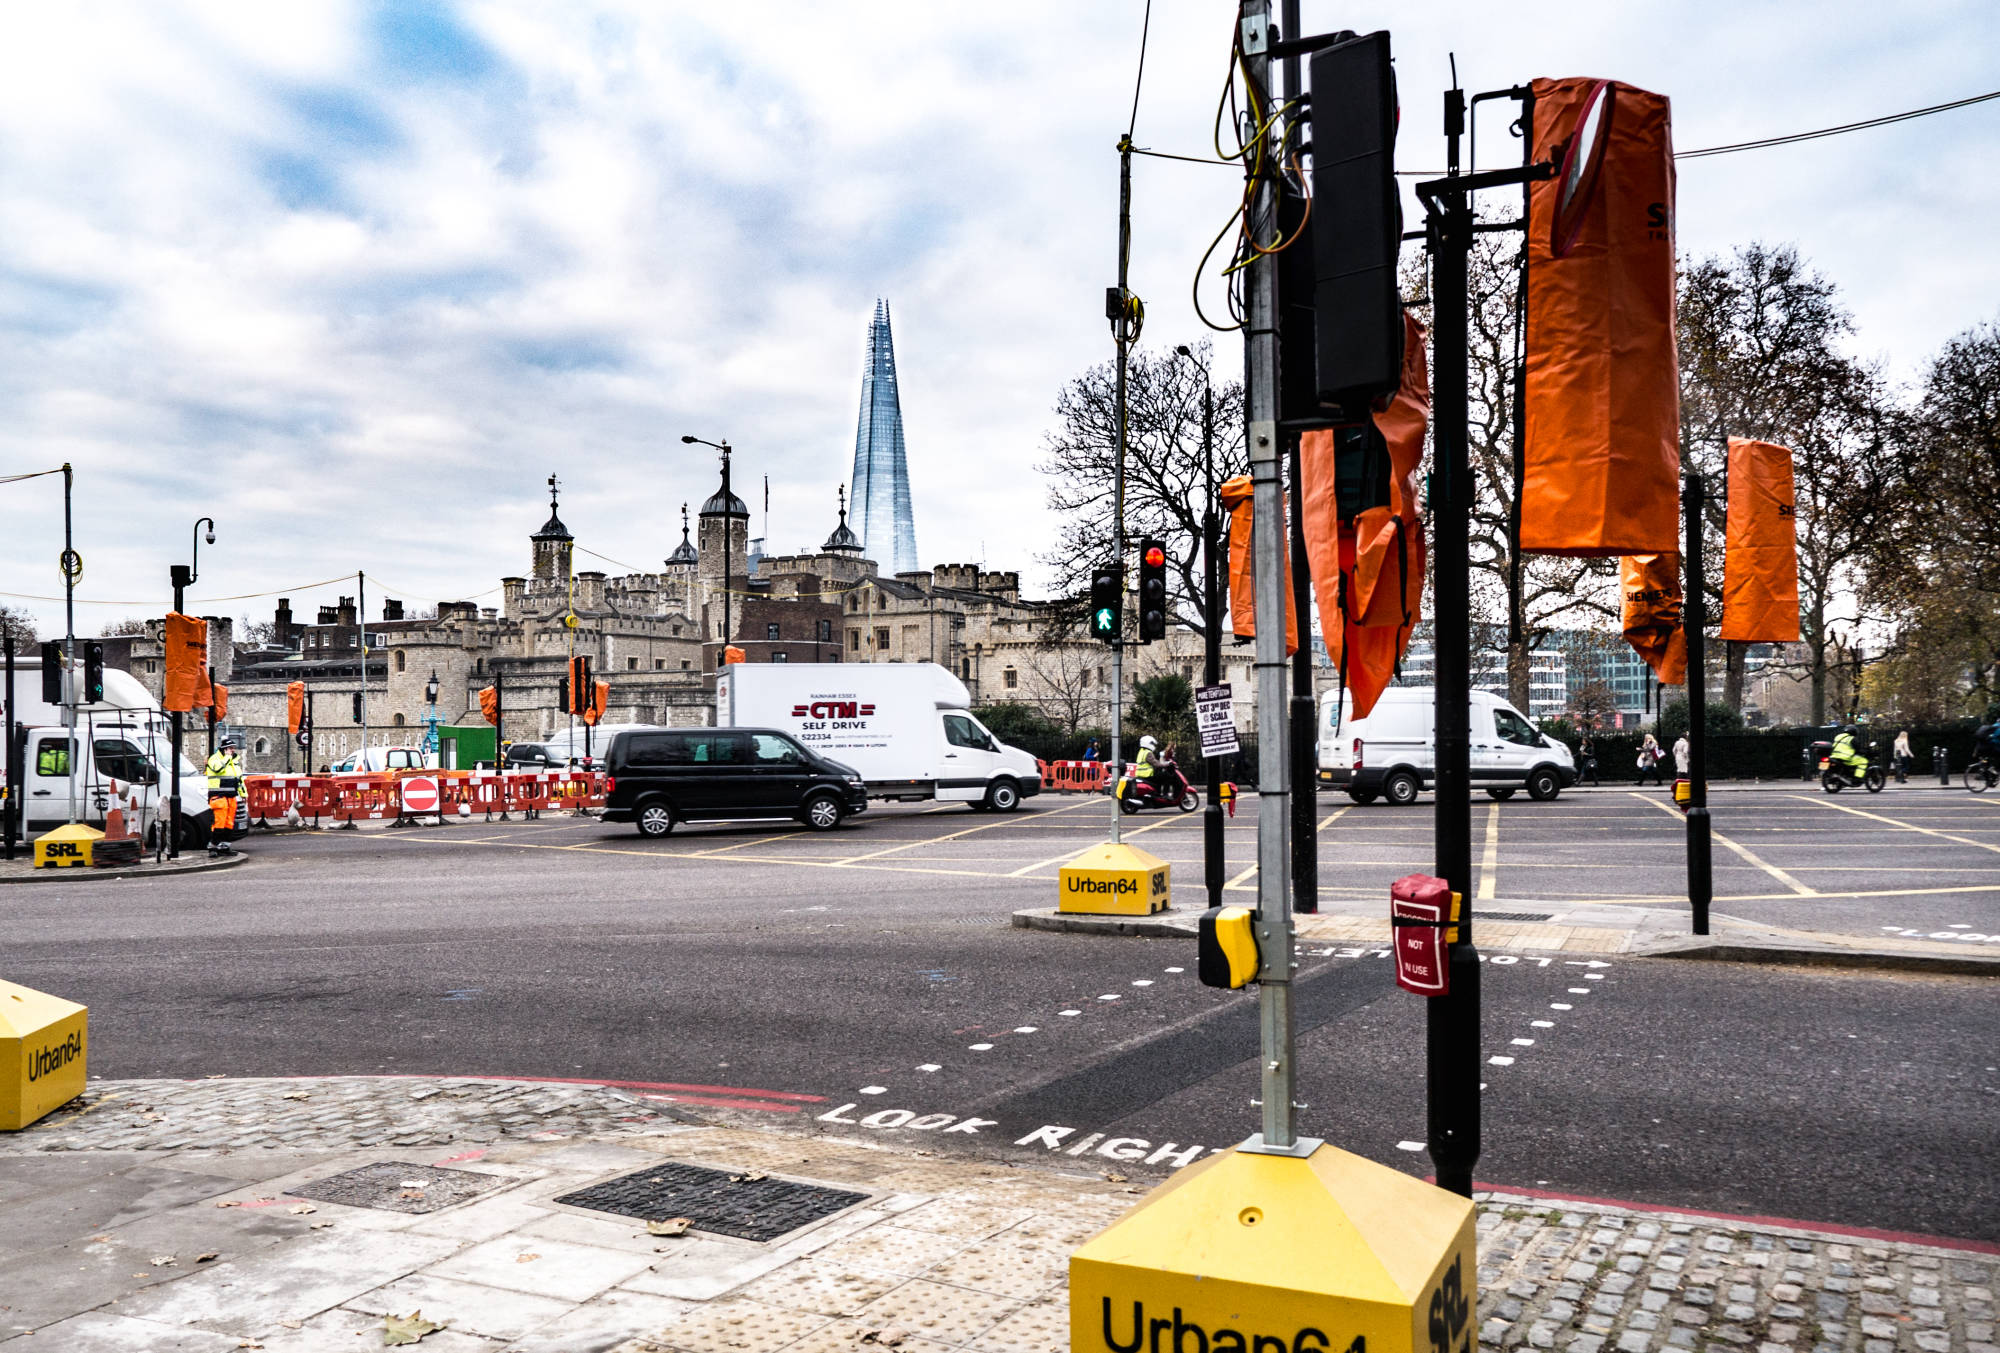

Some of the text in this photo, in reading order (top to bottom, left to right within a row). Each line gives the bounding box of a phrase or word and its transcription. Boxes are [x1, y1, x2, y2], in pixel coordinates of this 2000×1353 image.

[810, 701, 857, 719] CTM
[1199, 704, 1210, 713] SAT
[1220, 701, 1231, 711] DEC
[1210, 711, 1228, 721] SCALA
[802, 721, 867, 730] SELF DRIVE
[46, 843, 83, 857] SRL
[1067, 876, 1138, 894] Urban64
[1152, 871, 1167, 896] SRL
[1408, 939, 1424, 950] NOT
[1412, 964, 1429, 976] USE
[29, 1029, 82, 1082] Urban64
[817, 1103, 1226, 1167] LOOK RIGH
